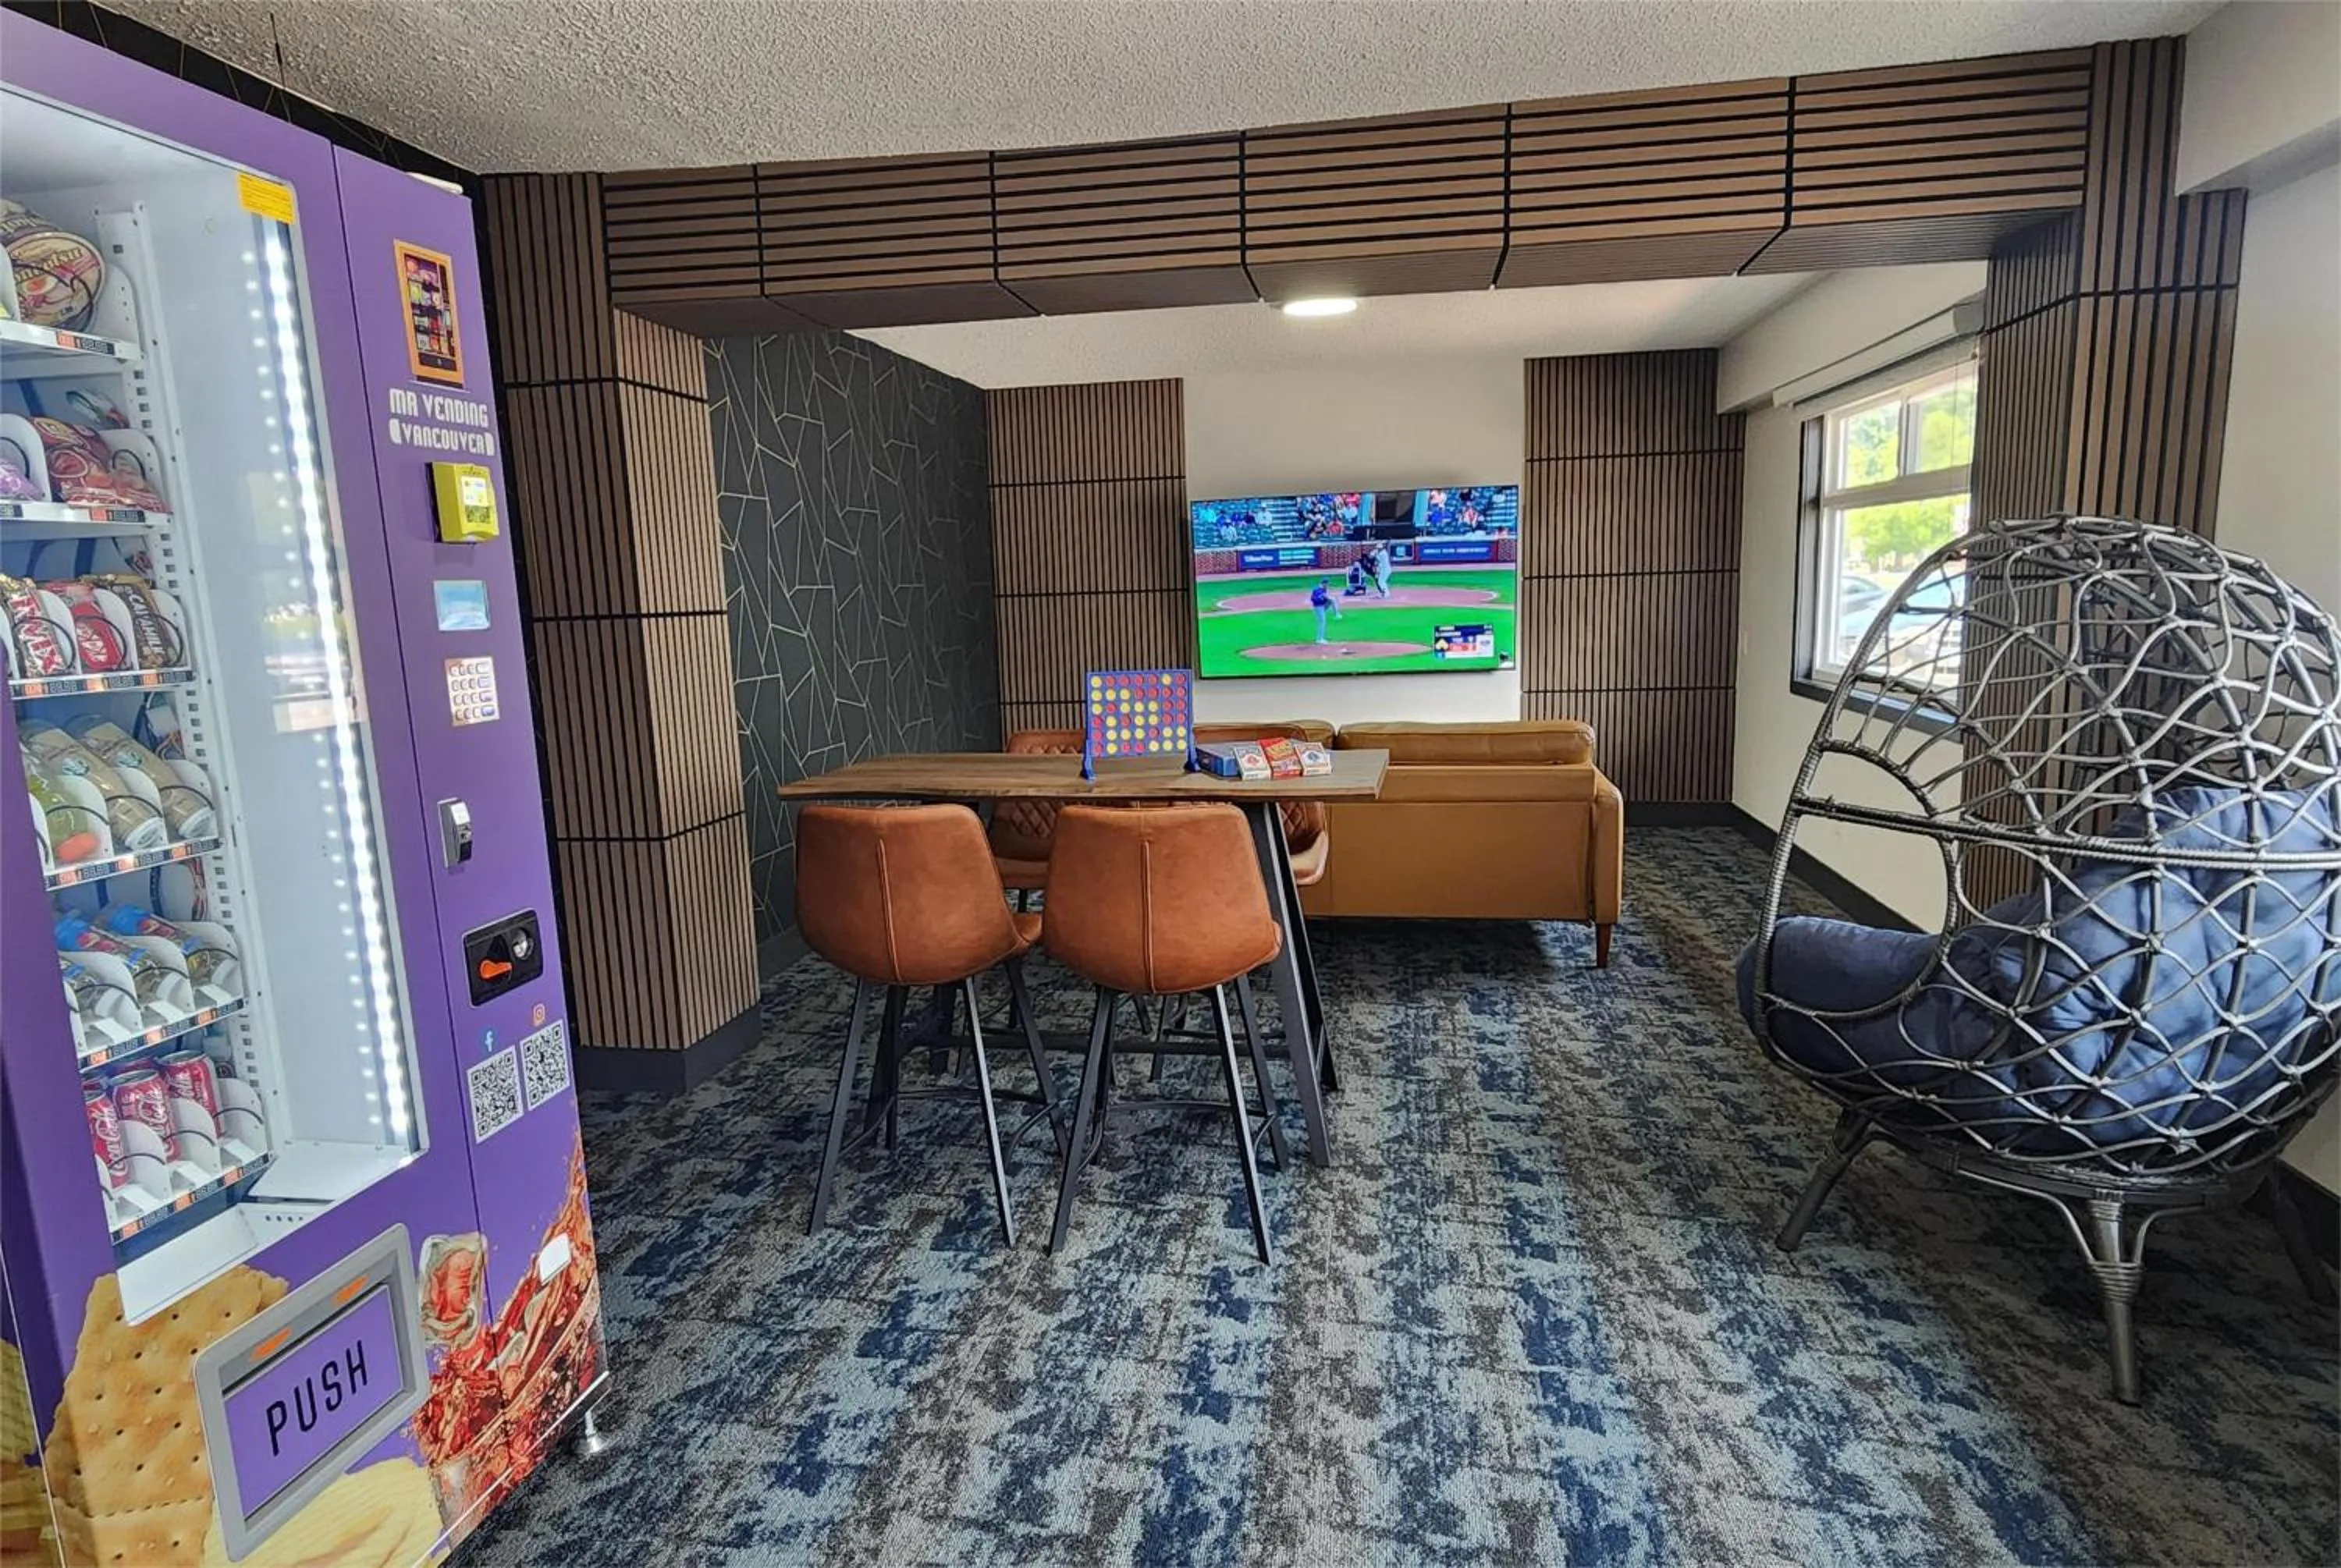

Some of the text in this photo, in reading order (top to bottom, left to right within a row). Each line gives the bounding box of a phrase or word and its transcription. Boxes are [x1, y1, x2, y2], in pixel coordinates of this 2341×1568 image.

[389, 388, 488, 427] MR VENDING
[402, 422, 485, 455] VANCOUVER
[266, 1339, 368, 1457] PUSH
